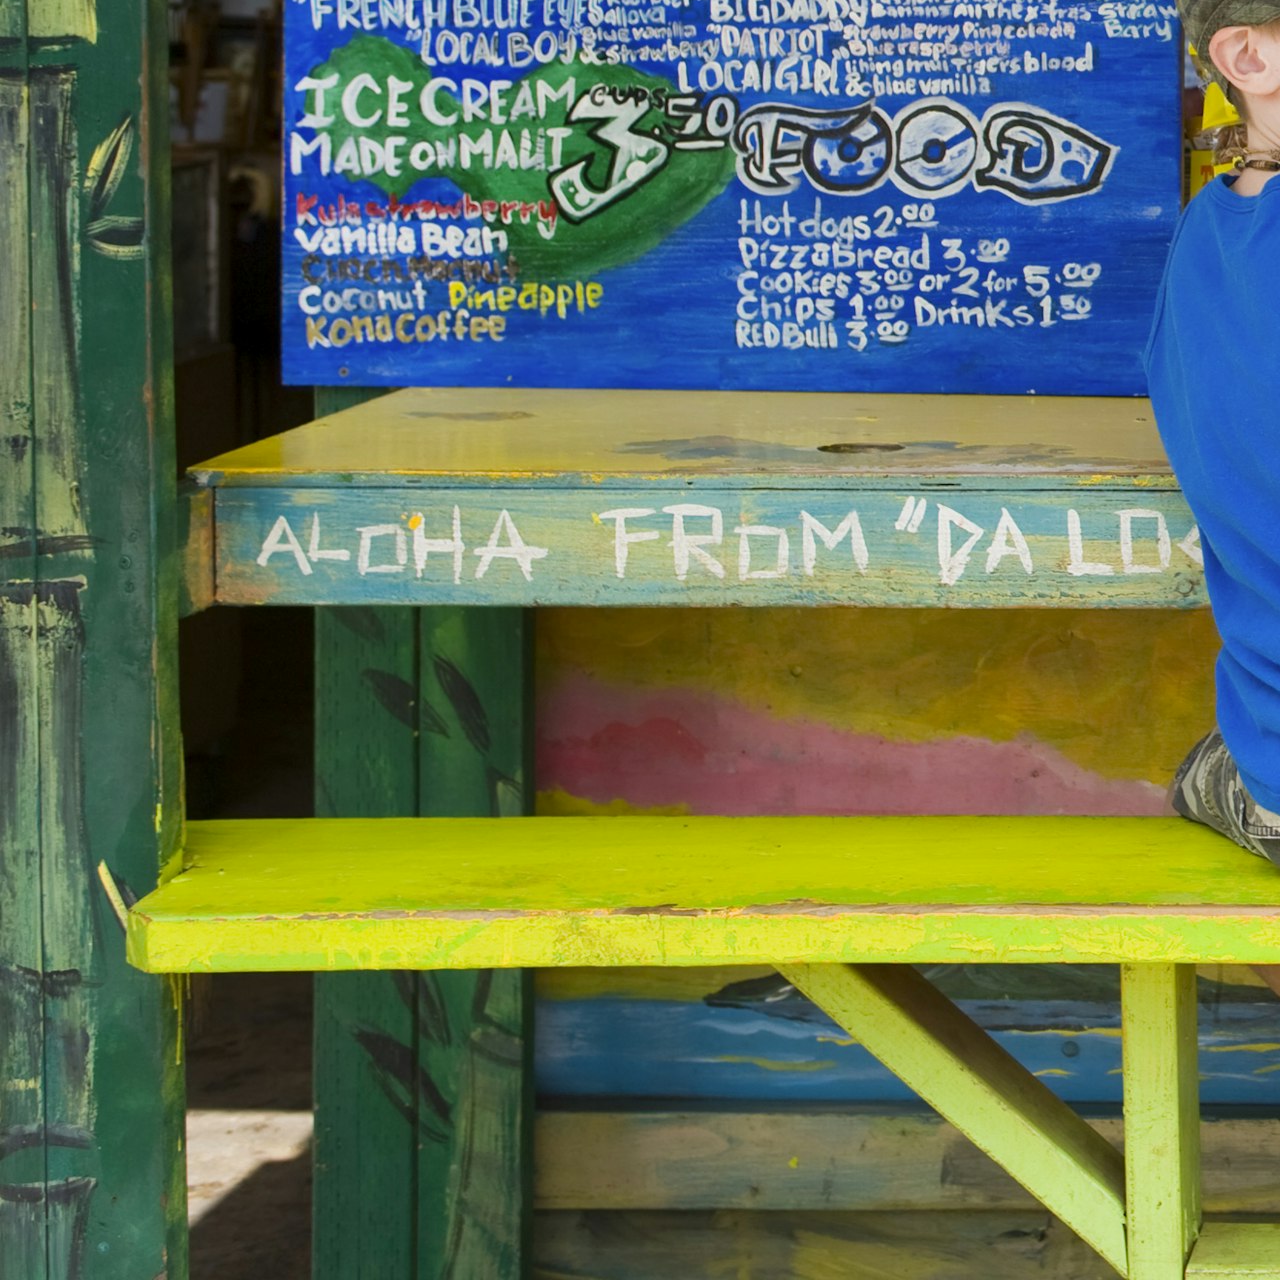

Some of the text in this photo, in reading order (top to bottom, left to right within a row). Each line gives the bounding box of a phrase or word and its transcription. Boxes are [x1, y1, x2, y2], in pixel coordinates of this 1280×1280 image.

[294, 72, 576, 129] ICE CREAM
[289, 132, 406, 177] MADE
[459, 128, 572, 174] MAUI
[422, 223, 508, 257] Bean
[738, 198, 798, 237] Hot
[801, 198, 871, 245] dogs
[920, 272, 949, 293] or
[951, 268, 979, 298] 2
[982, 270, 1017, 294] for
[736, 295, 836, 322] Chips
[256, 503, 548, 584] ALOHA
[596, 503, 869, 583] FROM
